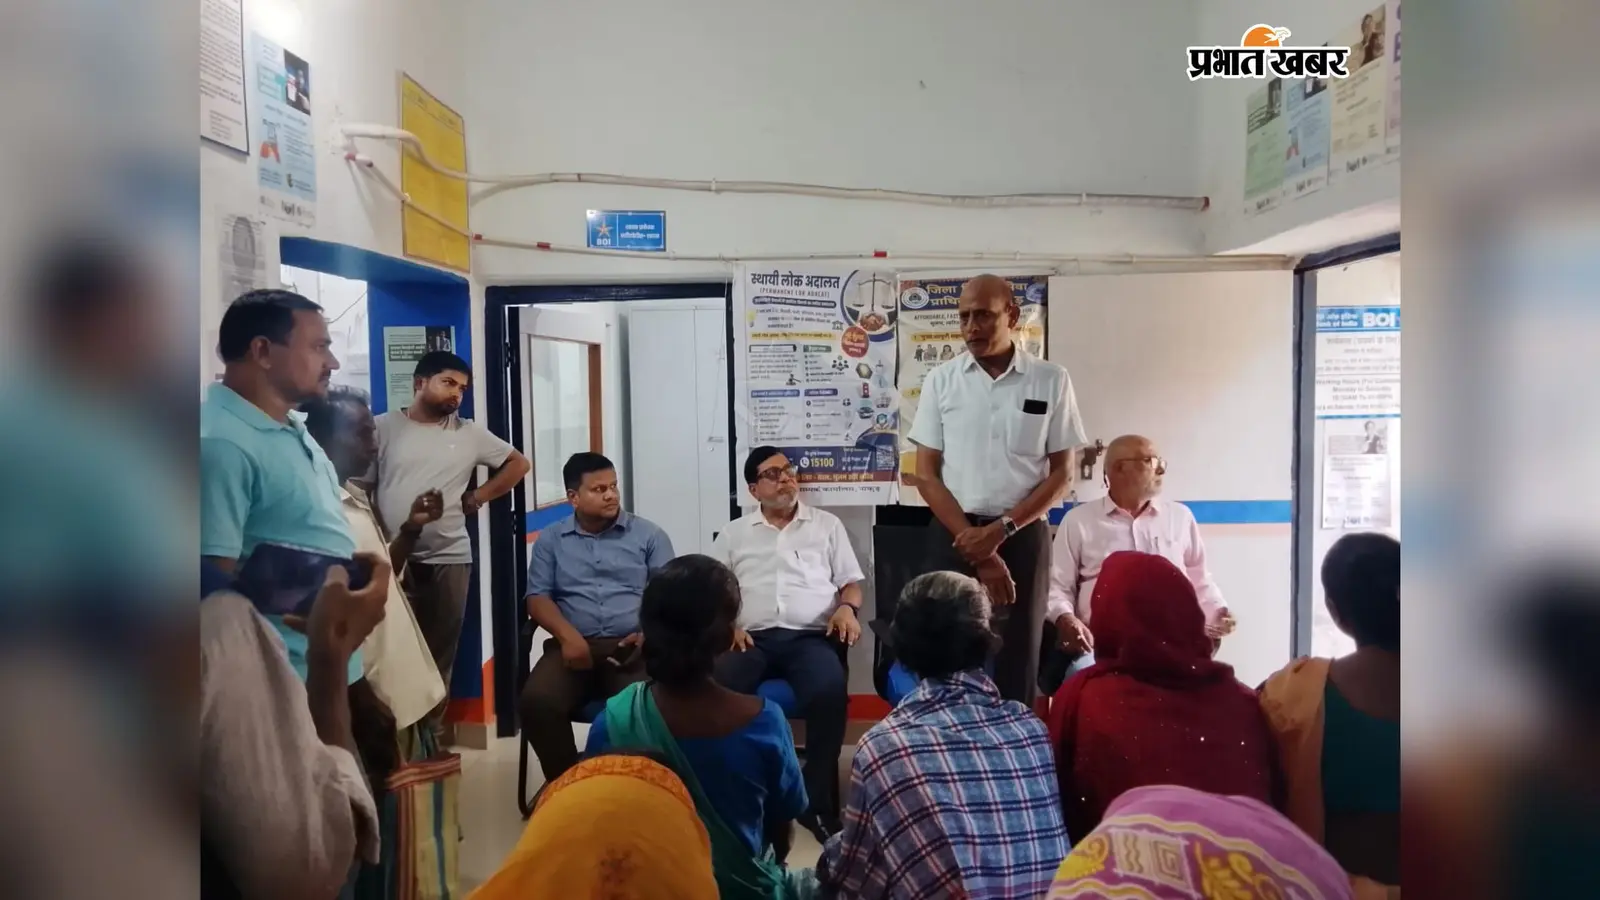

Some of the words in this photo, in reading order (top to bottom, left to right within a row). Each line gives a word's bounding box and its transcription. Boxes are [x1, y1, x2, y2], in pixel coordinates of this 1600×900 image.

[596, 238, 611, 246] BOI
[750, 269, 779, 286] स्थायी
[781, 271, 803, 287] लोक
[805, 275, 840, 289] अदालत
[926, 284, 957, 295] जिला
[1362, 312, 1396, 328] BOI
[810, 457, 835, 467] 15100
